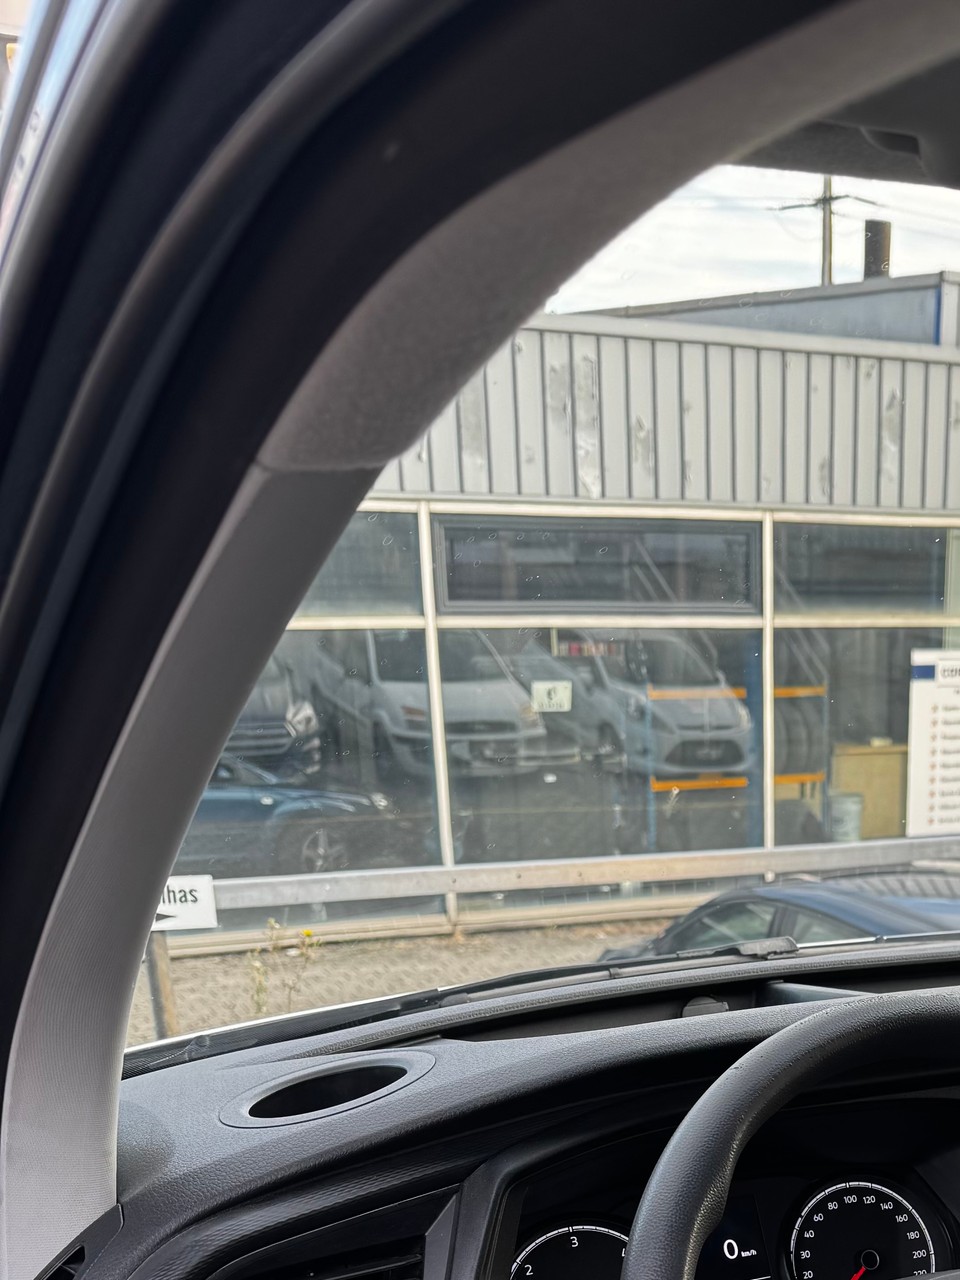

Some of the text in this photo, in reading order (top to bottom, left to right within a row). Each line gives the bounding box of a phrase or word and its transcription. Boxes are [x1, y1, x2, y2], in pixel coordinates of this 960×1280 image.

[843, 1194, 858, 1204] 100
[863, 1195, 876, 1204] 120
[827, 1201, 839, 1210] 80
[880, 1201, 894, 1210] 140
[813, 1213, 824, 1222] 60
[895, 1213, 909, 1223] 160
[804, 1230, 815, 1238] 40
[906, 1231, 920, 1240] 180
[570, 1236, 579, 1247] 3
[723, 1239, 757, 1259] 0 km/h
[800, 1250, 811, 1259] 30
[912, 1249, 927, 1259] 200
[524, 1264, 534, 1275] 2
[803, 1270, 813, 1279] 20
